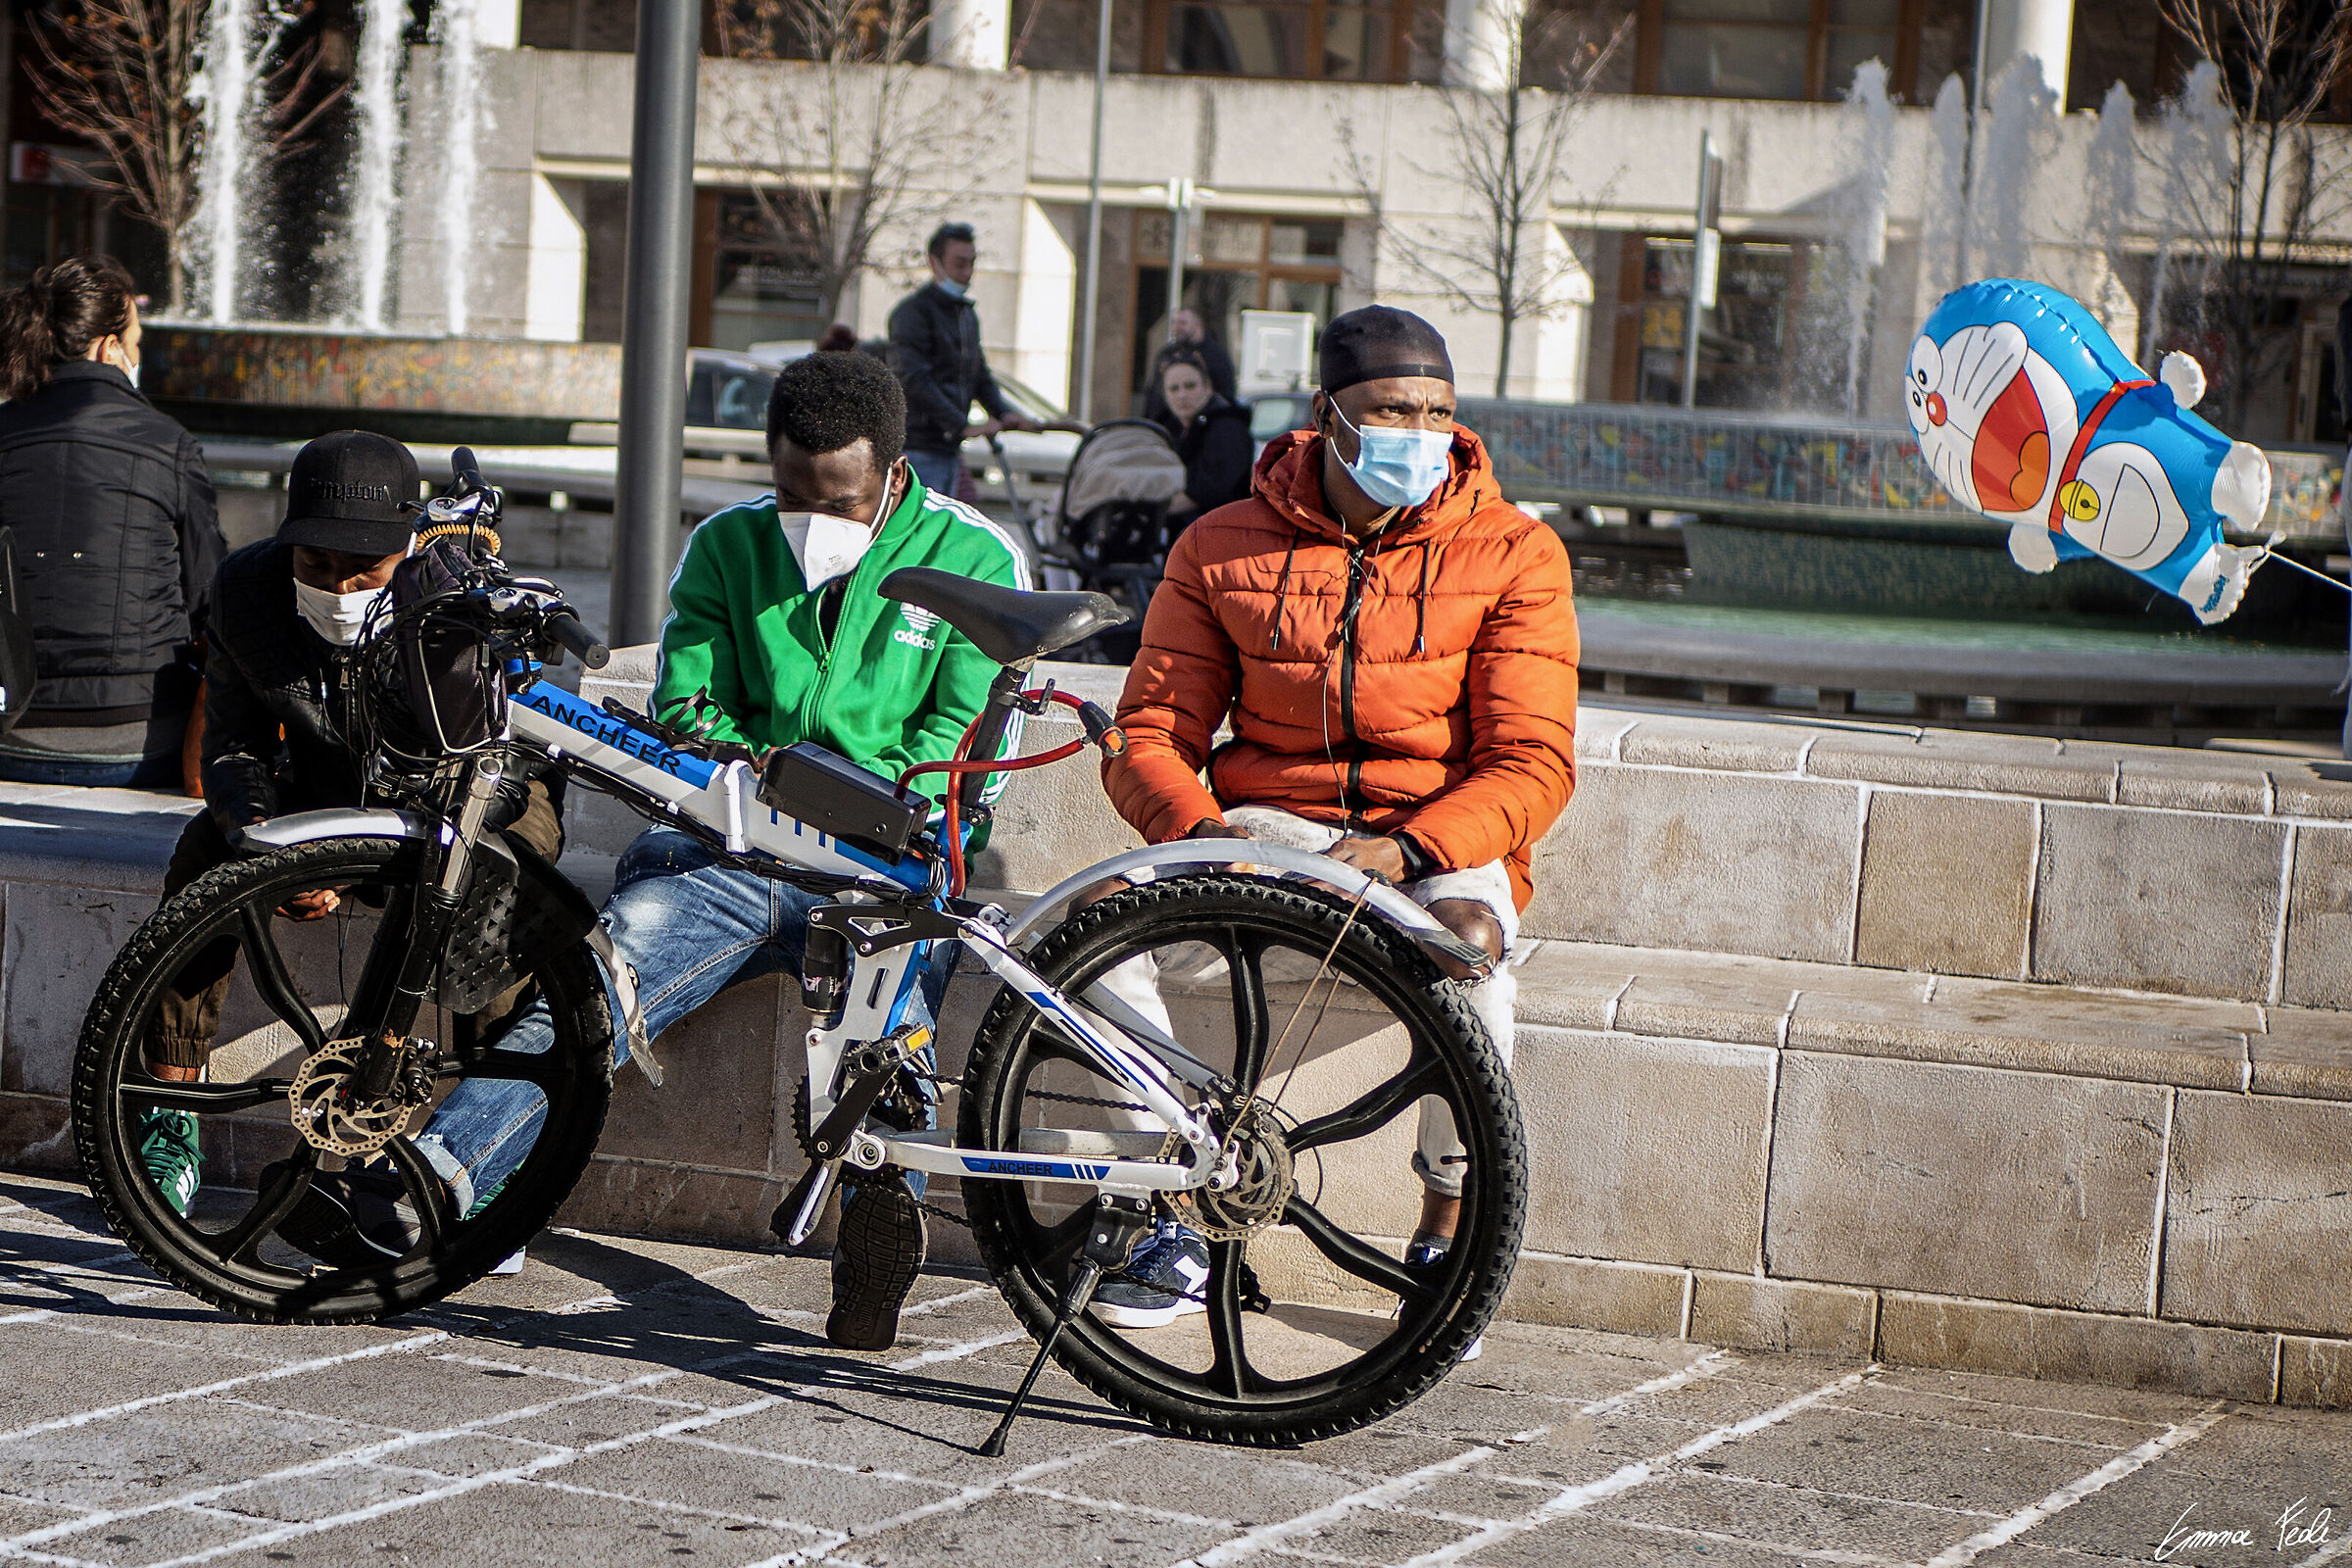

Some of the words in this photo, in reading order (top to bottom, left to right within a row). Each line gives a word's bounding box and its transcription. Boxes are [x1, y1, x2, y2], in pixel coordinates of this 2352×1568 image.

[894, 630, 935, 650] adidas
[530, 695, 681, 775] ANCHEER
[988, 1160, 1053, 1176] ANCHEER
